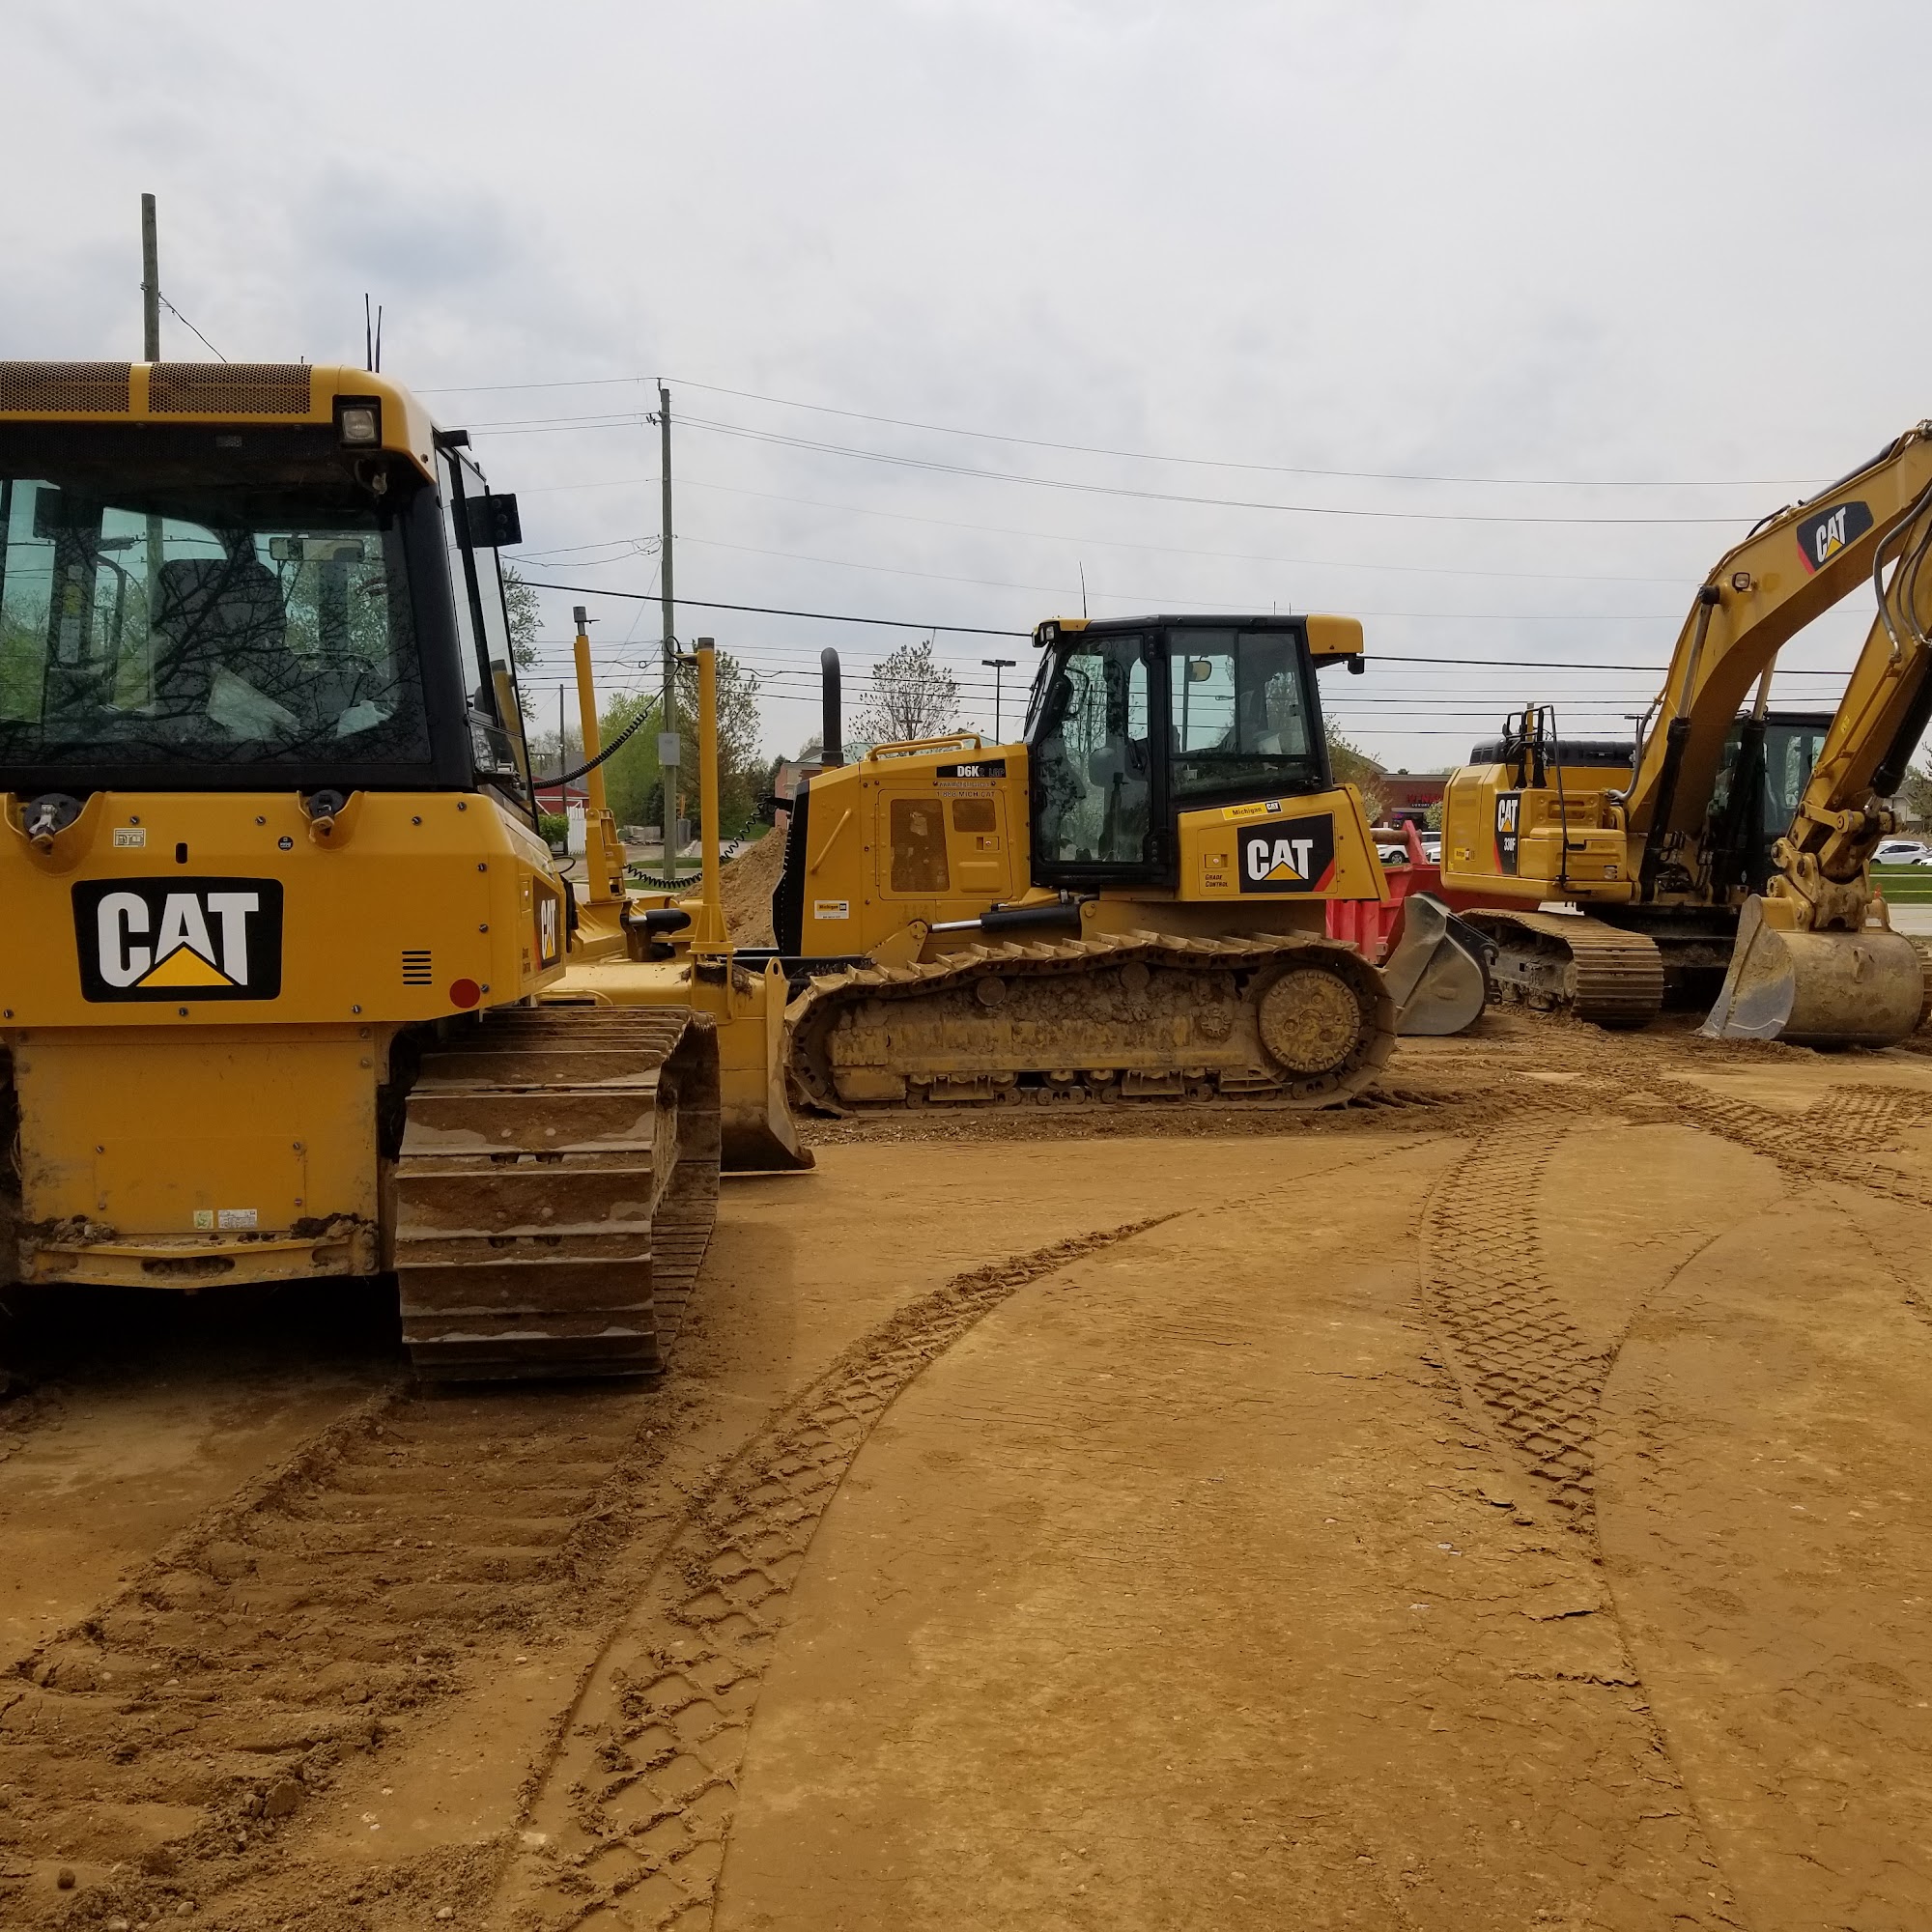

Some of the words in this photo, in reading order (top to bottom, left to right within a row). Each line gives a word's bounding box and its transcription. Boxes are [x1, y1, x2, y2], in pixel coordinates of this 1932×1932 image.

[1816, 506, 1846, 562] CAT
[1232, 807, 1263, 816] Michigan
[1497, 799, 1519, 832] CAT
[1247, 838, 1314, 881] CAT
[98, 892, 259, 987] CAT
[541, 898, 556, 960] CAT
